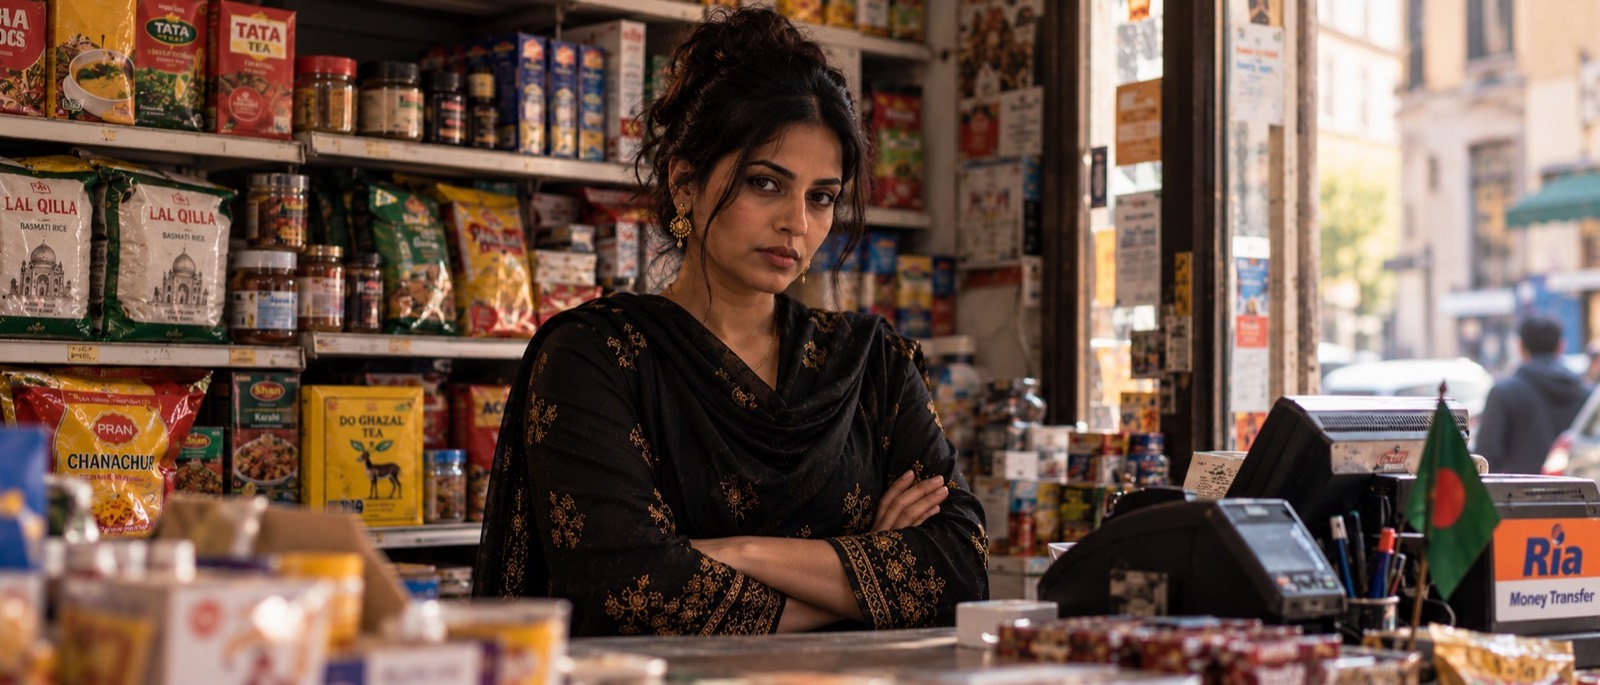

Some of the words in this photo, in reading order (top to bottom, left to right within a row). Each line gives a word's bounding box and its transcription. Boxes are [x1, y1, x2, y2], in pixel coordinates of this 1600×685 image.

[154, 22, 189, 38] TATA
[236, 22, 281, 43] TATA
[248, 41, 271, 54] TEA
[5, 196, 33, 212] LAL
[37, 198, 77, 215] QILLA
[149, 206, 175, 222] LAL
[177, 208, 216, 226] QILLA
[20, 222, 51, 232] BASMATI
[52, 224, 67, 232] RICE
[162, 231, 190, 241] BASMATI
[191, 234, 205, 242] RICE
[255, 385, 281, 396] Shan
[482, 400, 506, 415] AC
[339, 415, 356, 427] DO
[358, 415, 405, 427] GHAZAL
[97, 423, 133, 436] PRAN
[362, 428, 384, 439] TEA
[67, 453, 155, 471] CHANACHUR
[1523, 523, 1584, 578] Ria
[1509, 591, 1548, 610] Money
[1550, 588, 1595, 605] Transfer
